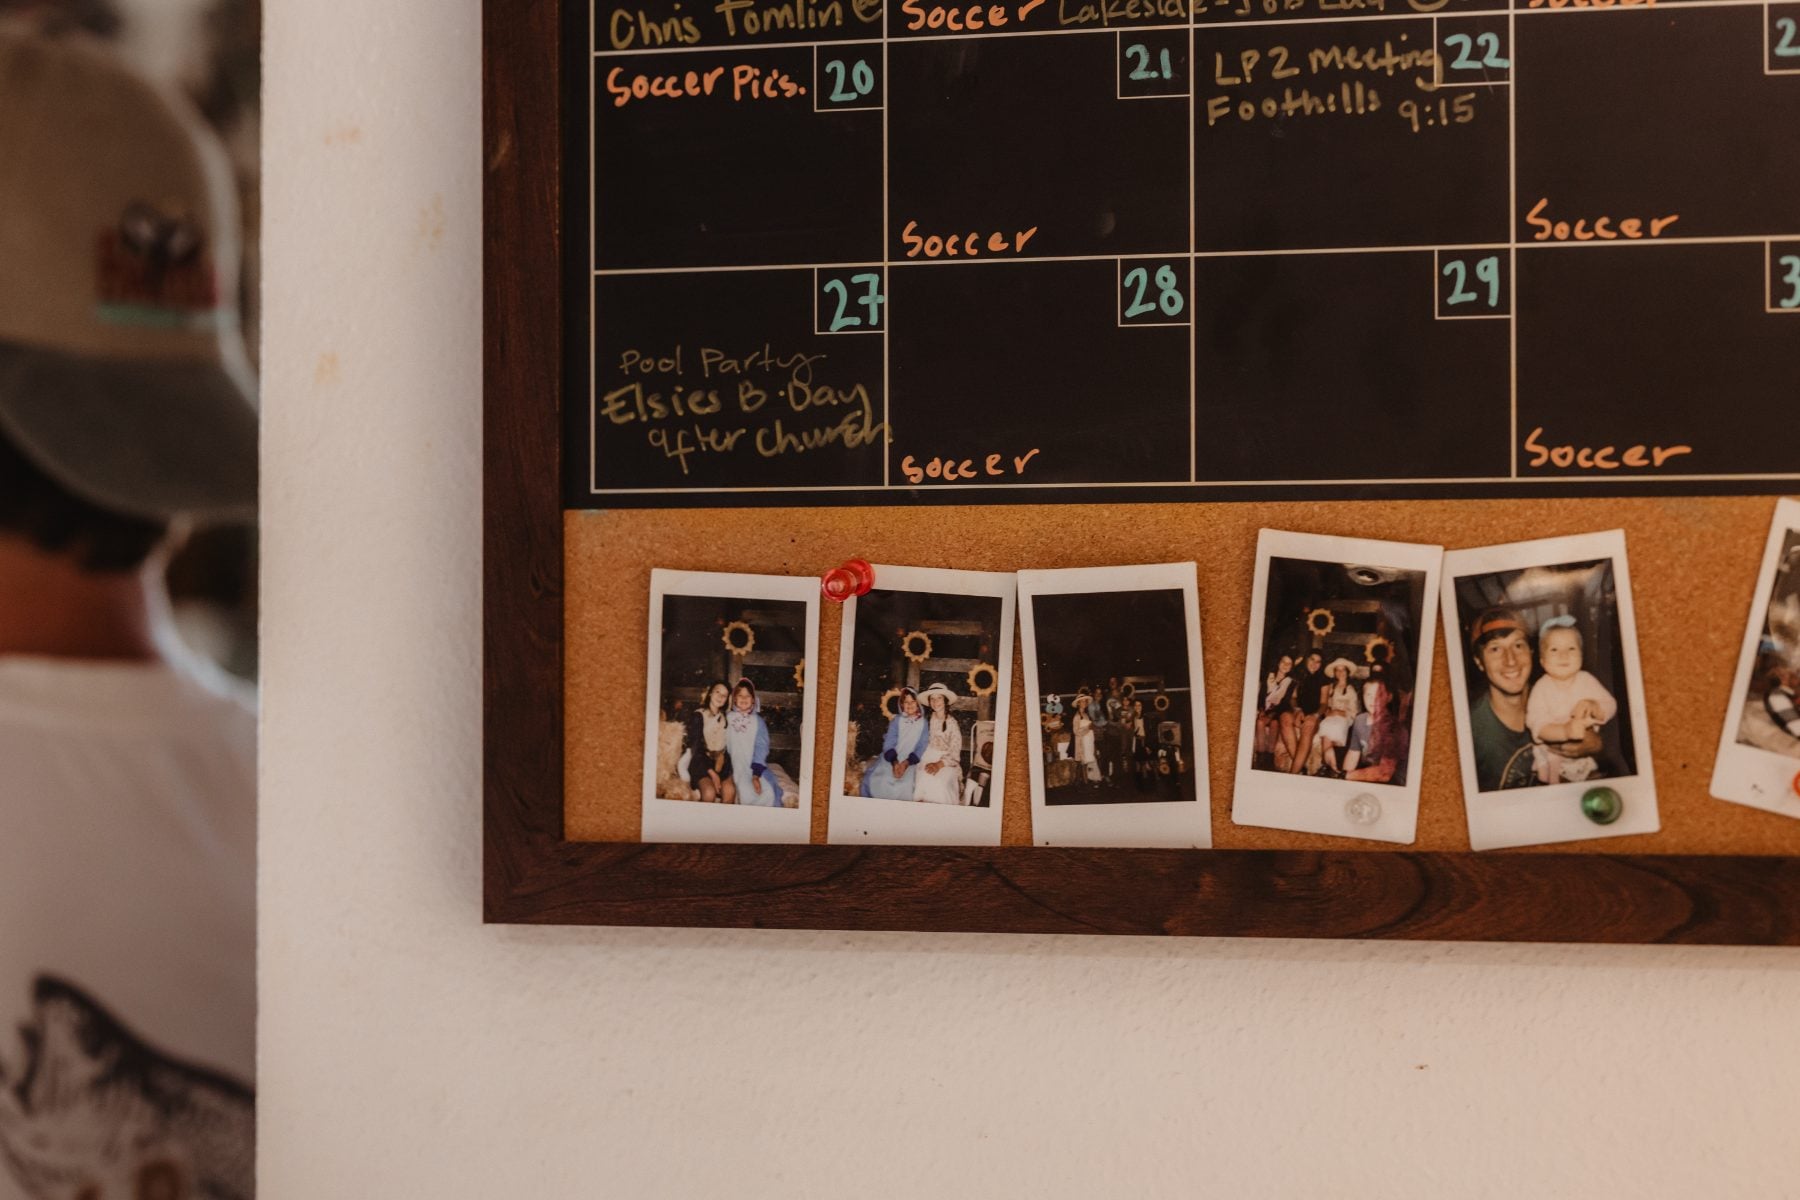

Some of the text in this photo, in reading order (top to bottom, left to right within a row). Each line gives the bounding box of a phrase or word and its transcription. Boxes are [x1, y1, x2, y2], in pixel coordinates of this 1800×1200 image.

[610, 4, 702, 49] Chris
[714, 0, 844, 36] Tomlin
[901, 0, 1046, 31] Soccer
[1126, 43, 1174, 80] 21
[1444, 33, 1511, 70] 22
[606, 66, 724, 108] Soccer
[825, 59, 876, 102] 20
[1206, 80, 1476, 133] Foothills 9:15
[902, 220, 1039, 258] Soccer
[1525, 198, 1680, 241] Soccer
[823, 273, 885, 332] 27
[1123, 264, 1185, 318] 28
[1443, 256, 1500, 307] 29
[619, 343, 828, 386] Pool Party
[601, 382, 722, 425] Elsies
[648, 409, 895, 476] after church
[1524, 427, 1693, 469] Soccer
